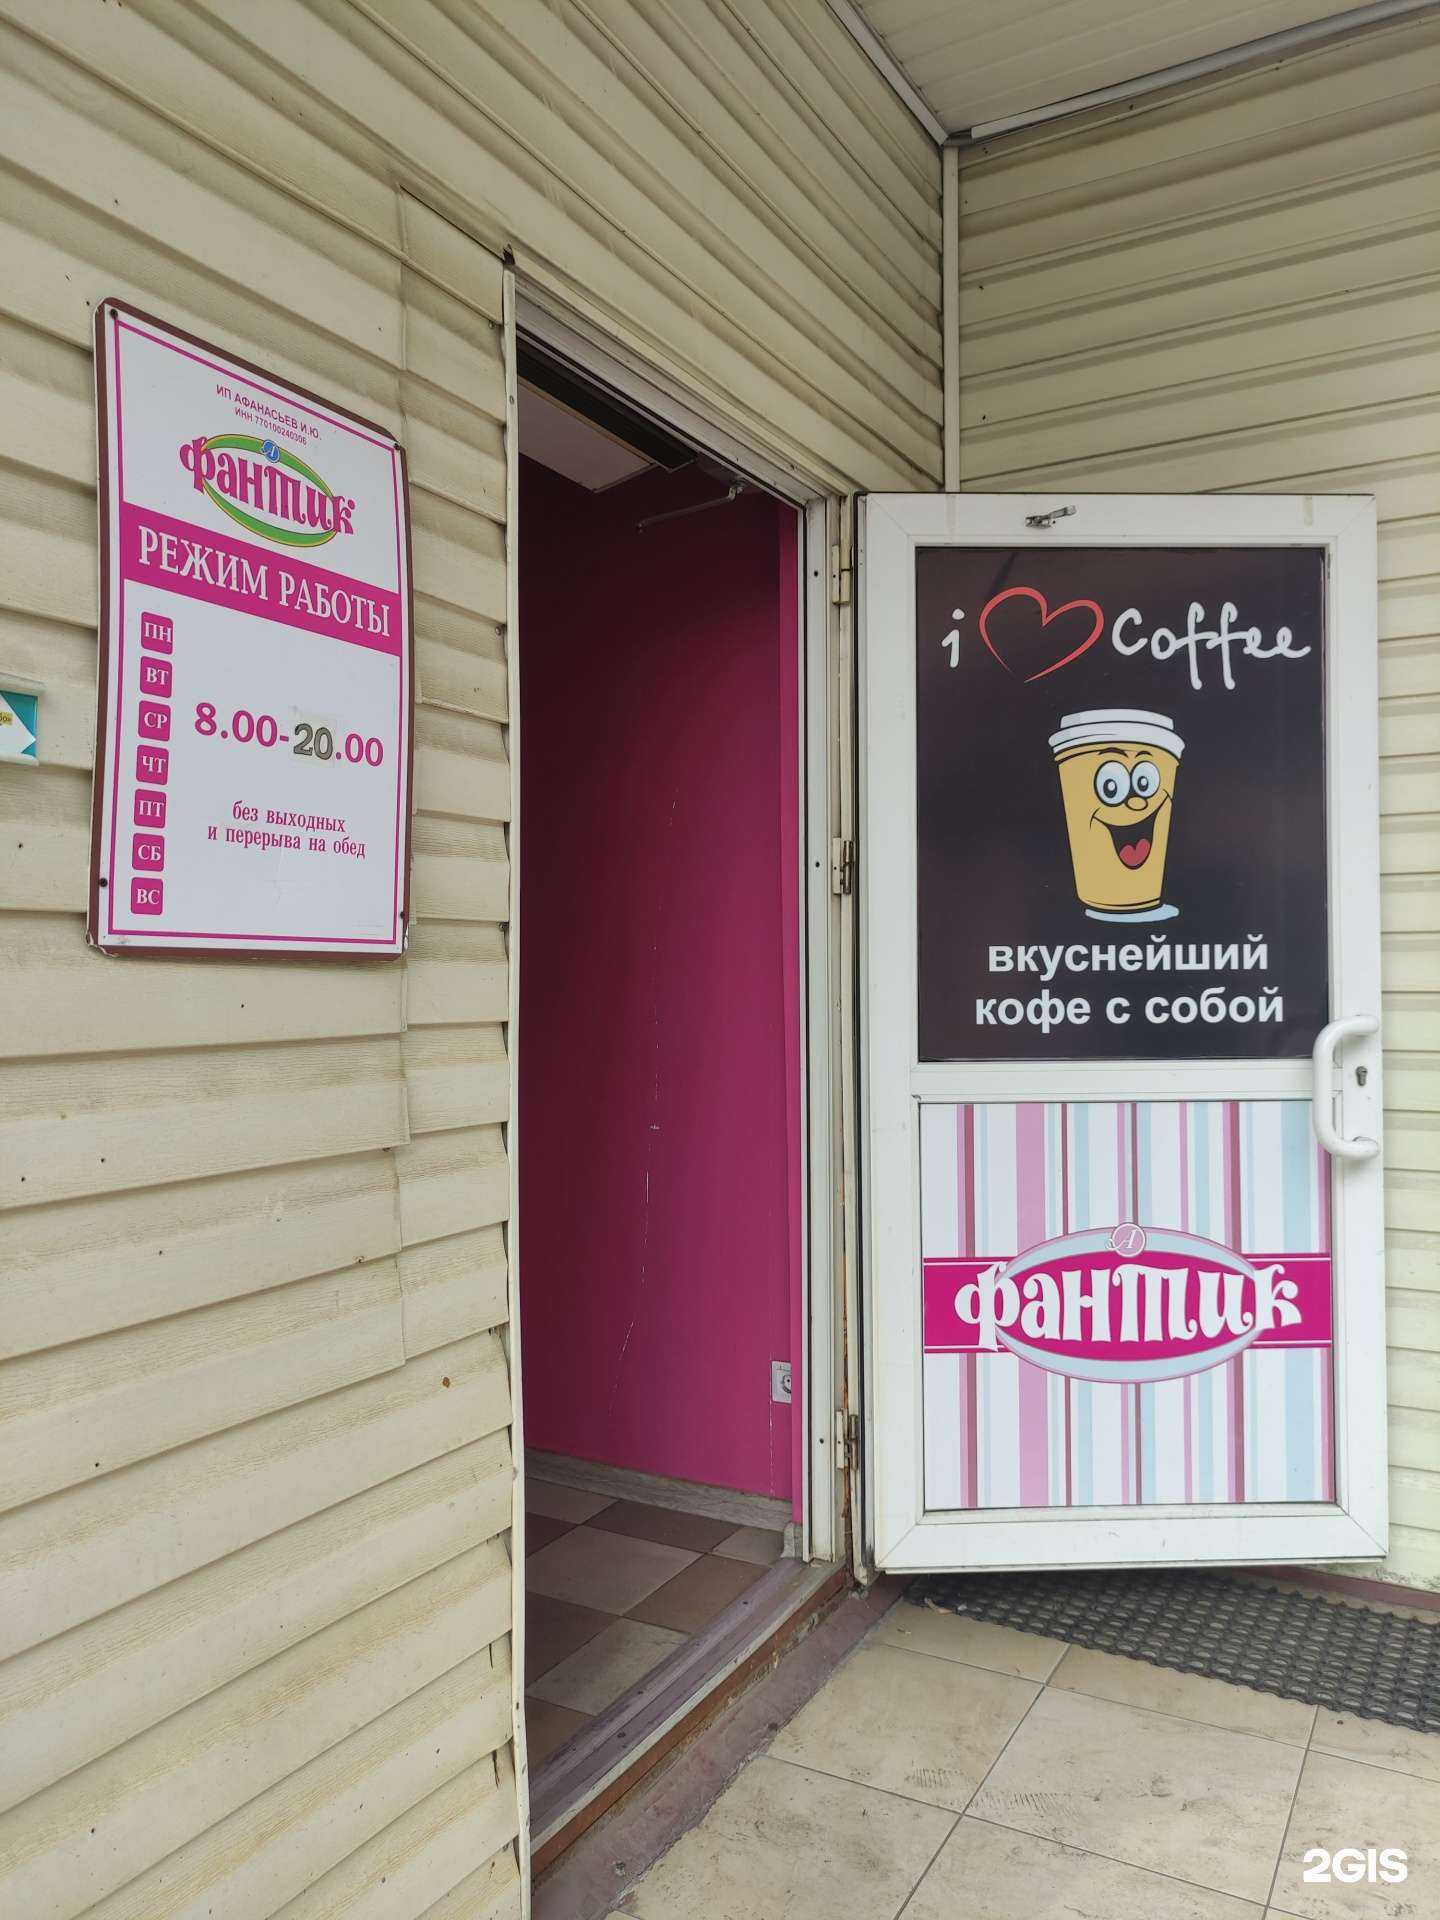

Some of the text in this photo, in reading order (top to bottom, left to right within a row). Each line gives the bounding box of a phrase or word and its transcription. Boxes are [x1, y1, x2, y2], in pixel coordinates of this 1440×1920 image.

[216, 383, 322, 441] ИП АФАНАСЬЕВ И.Ю.
[234, 407, 253, 422] ИНН
[138, 525, 390, 637] РЕЖИМ РАБОТЫ
[143, 621, 172, 644] ПН
[145, 666, 169, 685] ВТ
[143, 711, 168, 730] СР
[142, 755, 166, 773] ЧТ
[138, 799, 165, 818] ПТ
[232, 800, 346, 832] без выходных
[137, 844, 162, 861] СБ
[207, 825, 366, 859] и перерыва на обед
[135, 888, 160, 905] ВС
[988, 933, 1269, 982] вкуснейший
[975, 985, 1284, 1034] кофе с собой
